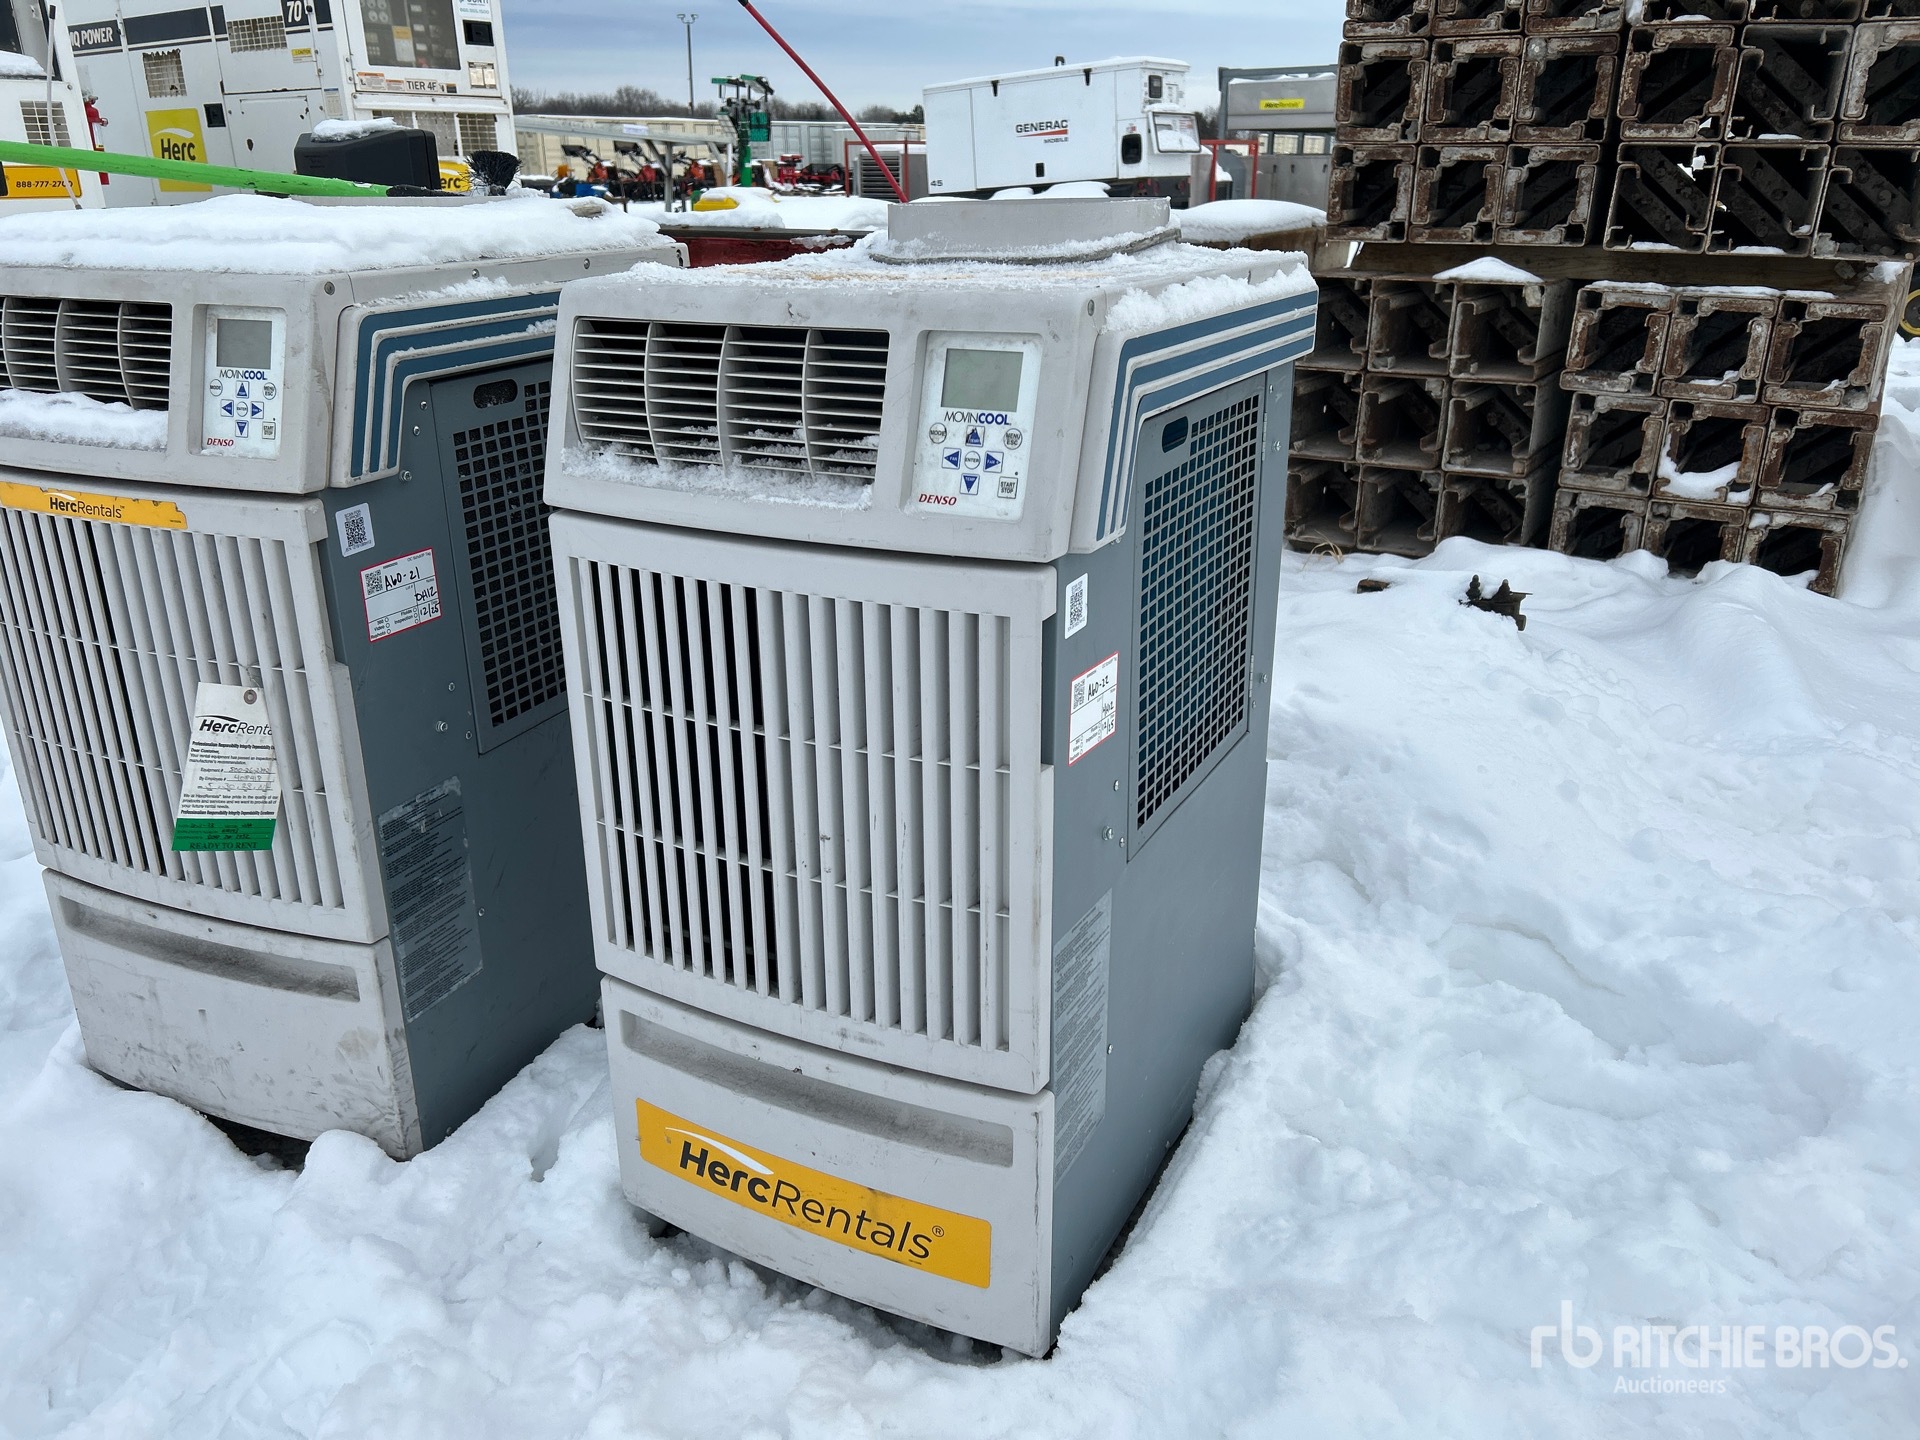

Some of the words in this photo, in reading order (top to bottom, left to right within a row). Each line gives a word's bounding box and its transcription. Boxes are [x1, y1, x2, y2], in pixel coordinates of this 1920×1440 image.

[81, 27, 114, 45] POWER
[406, 80, 426, 91] TIER
[427, 81, 437, 91] 4F
[1015, 119, 1068, 134] GENERAC
[1043, 136, 1069, 144] MOBILE
[161, 138, 196, 161] Herc
[440, 177, 462, 189] erc
[219, 369, 267, 381] MOVINCOOL
[944, 411, 1010, 425] MOVINCOOL
[206, 437, 234, 447] DENSO
[1005, 432, 1020, 440] MENU
[918, 493, 957, 506] DENSO
